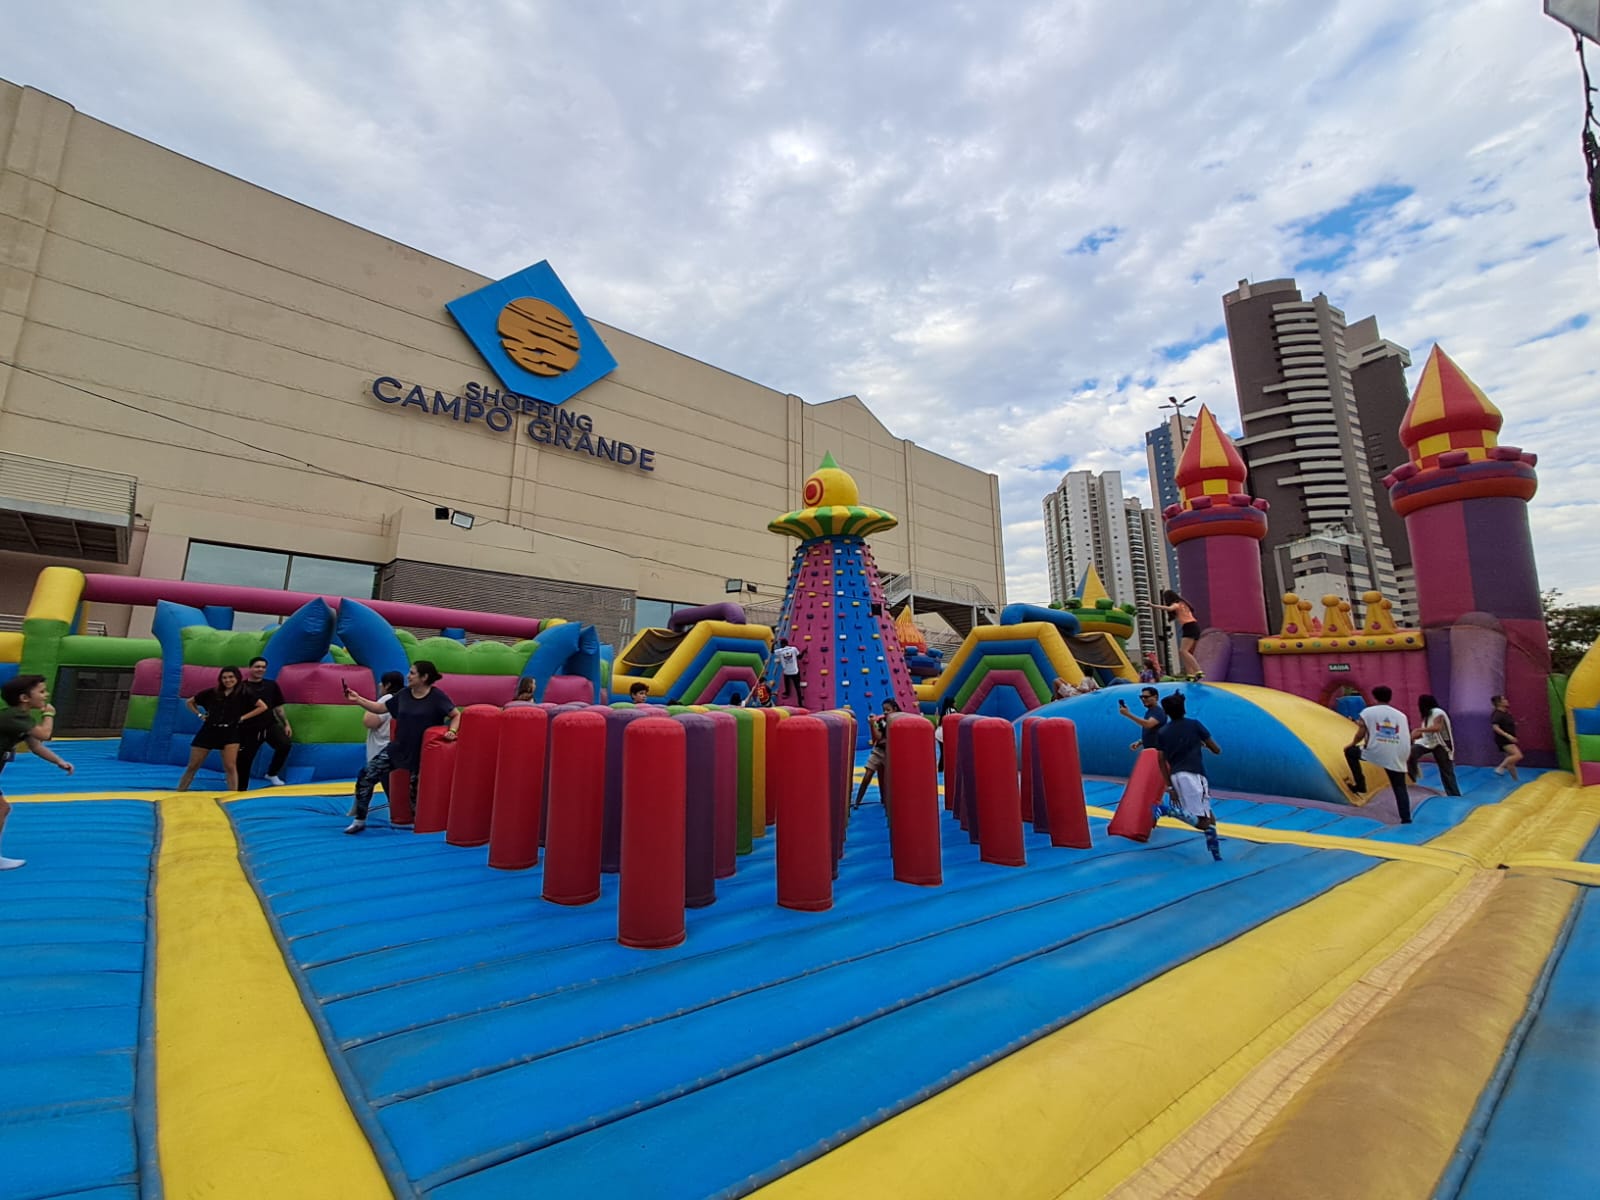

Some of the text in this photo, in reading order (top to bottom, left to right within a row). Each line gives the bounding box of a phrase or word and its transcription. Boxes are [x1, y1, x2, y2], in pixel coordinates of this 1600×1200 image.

[372, 376, 656, 471] CAMPO GRANDE
[465, 381, 593, 432] SHOPPING
